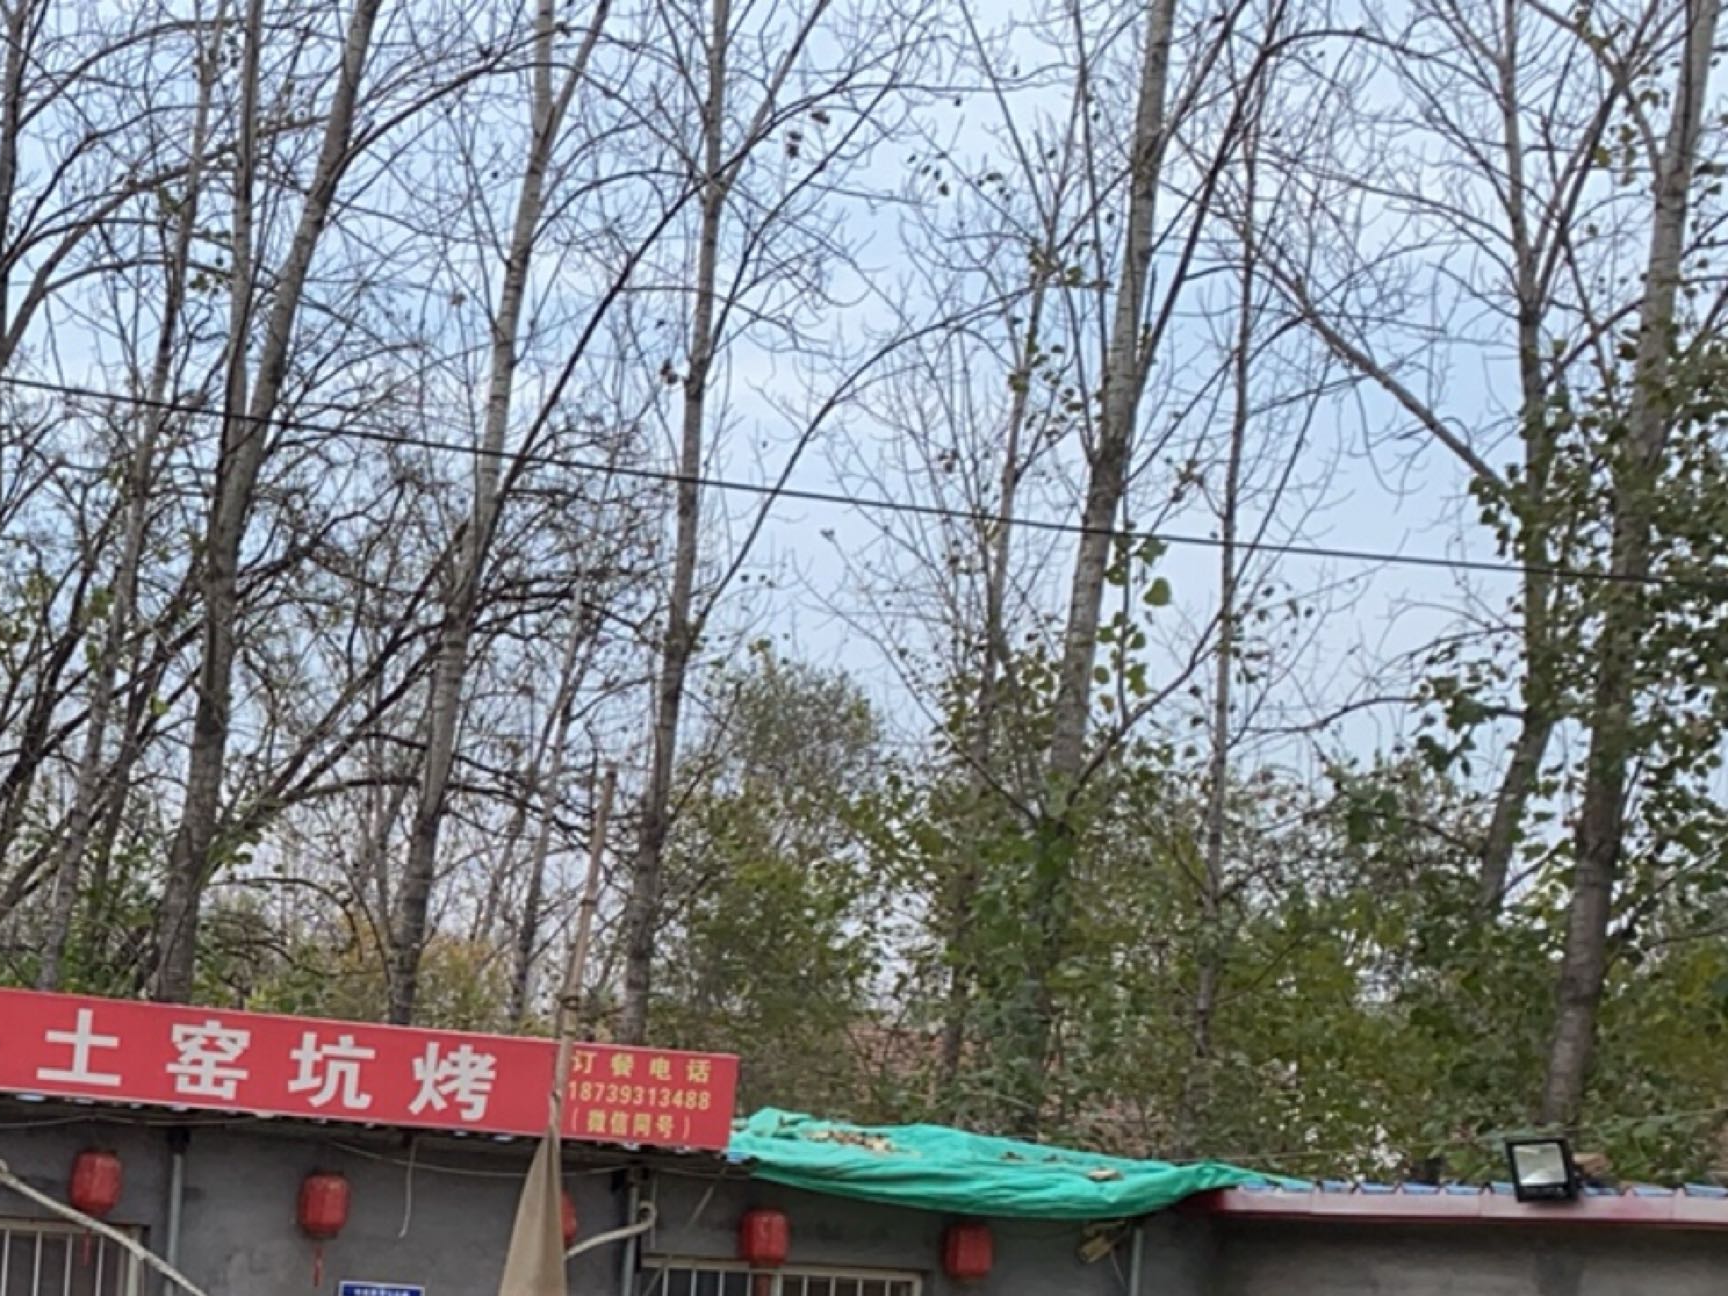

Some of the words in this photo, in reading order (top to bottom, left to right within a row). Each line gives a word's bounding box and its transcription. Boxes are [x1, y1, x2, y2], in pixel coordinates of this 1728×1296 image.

[571, 1050, 711, 1083] 订餐电话
[568, 1081, 711, 1110] 18739313488
